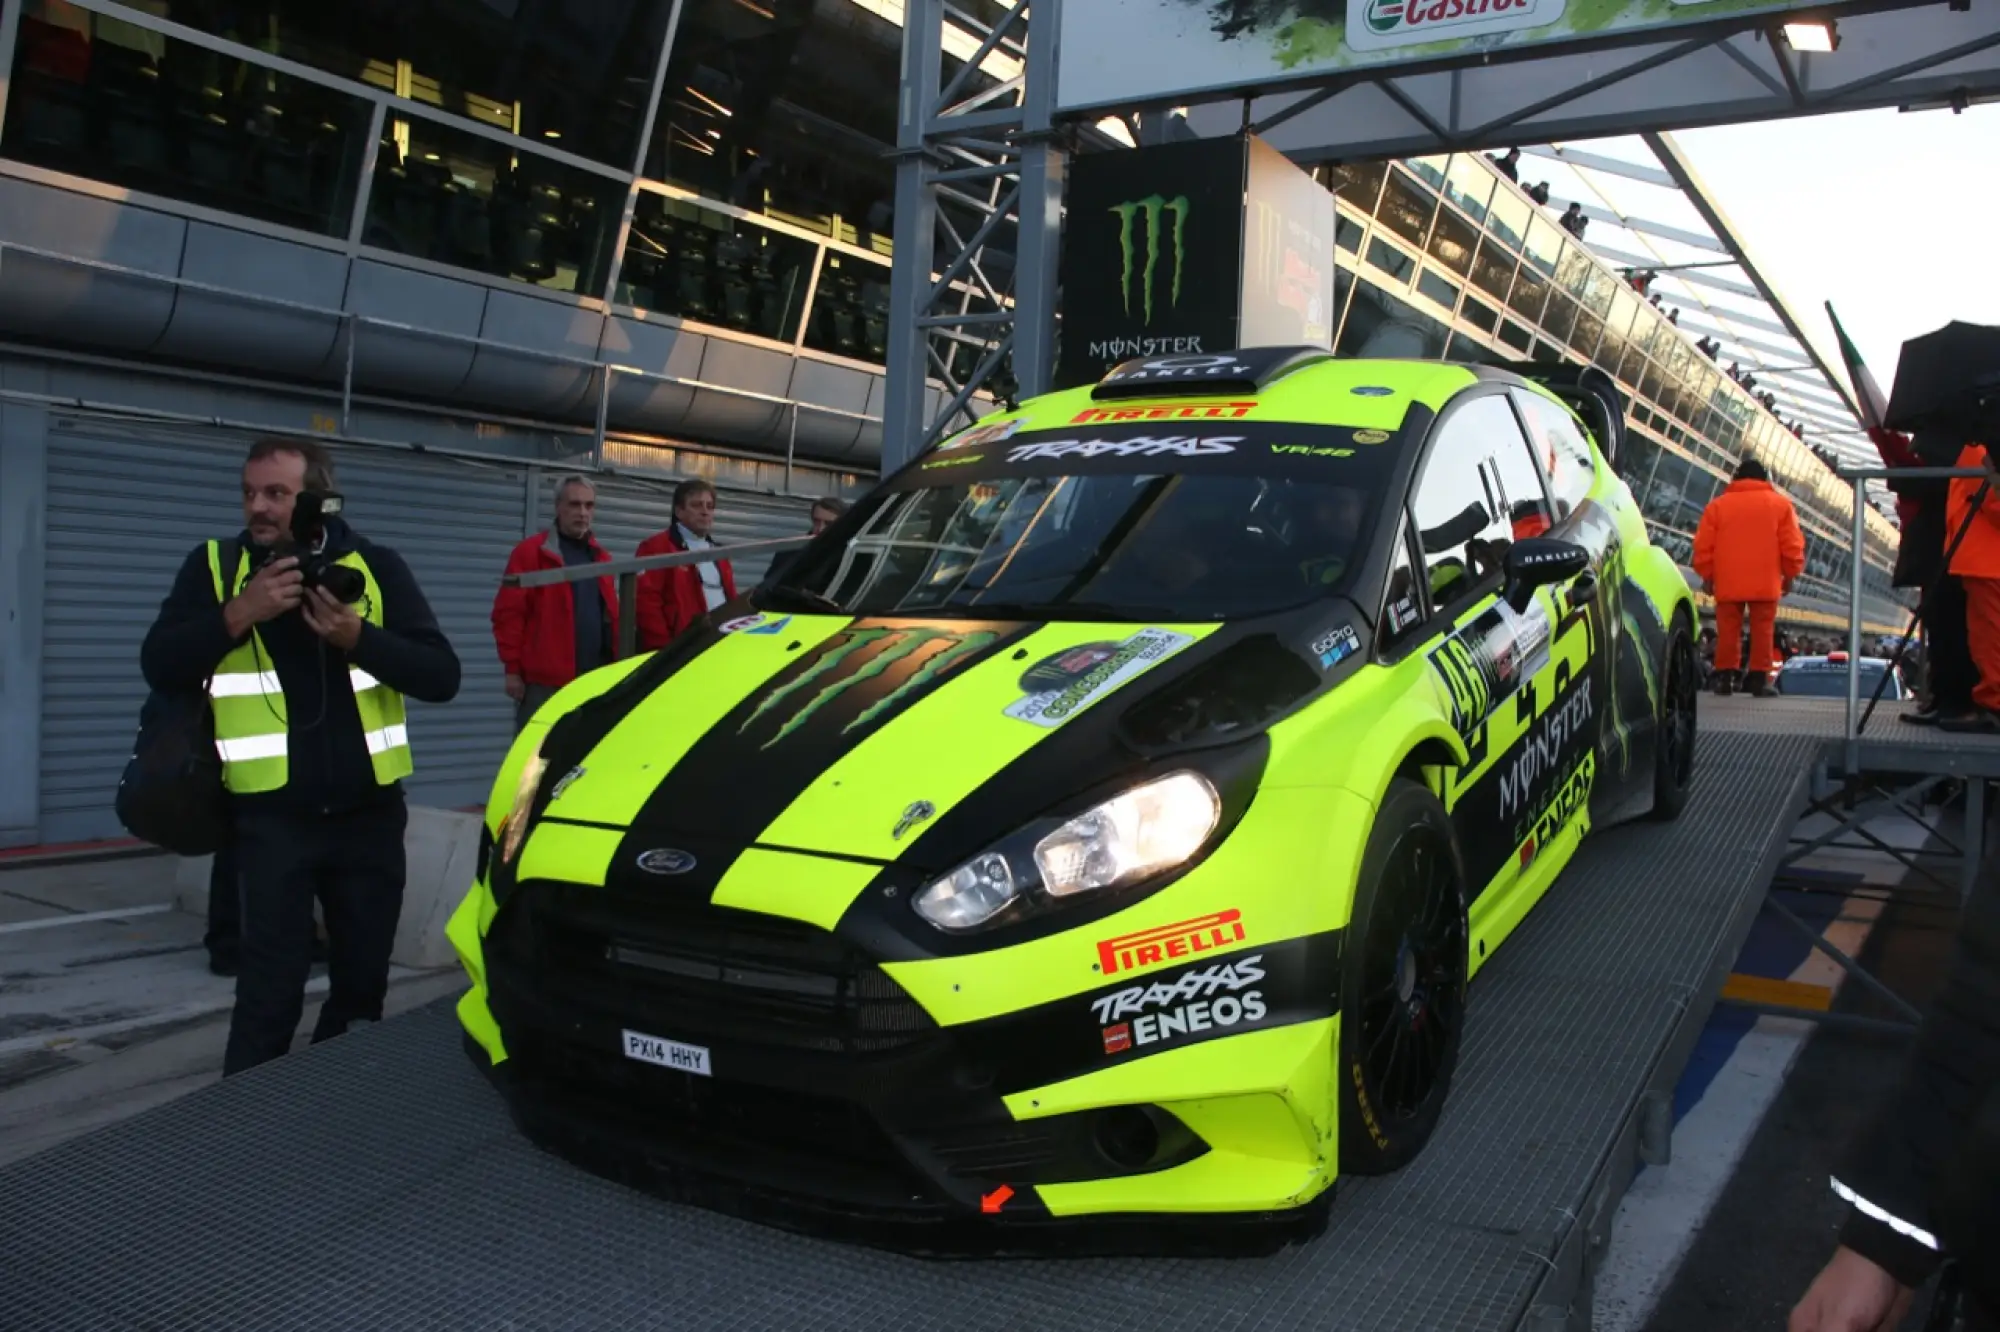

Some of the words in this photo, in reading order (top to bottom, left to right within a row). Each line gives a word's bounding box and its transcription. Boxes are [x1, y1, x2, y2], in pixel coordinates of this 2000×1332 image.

[1071, 402, 1258, 424] PIRELLI
[1005, 436, 1246, 463] TRAXXAS
[1524, 550, 1576, 563] OAKLEY
[1312, 625, 1354, 654] GoPro
[1436, 639, 1487, 731] 46
[1096, 908, 1246, 975] PIRELLI
[1091, 954, 1266, 1024] TRAXXAS
[1133, 991, 1267, 1045] ENEOS
[630, 1036, 665, 1061] PX14
[670, 1045, 703, 1069] HHY
